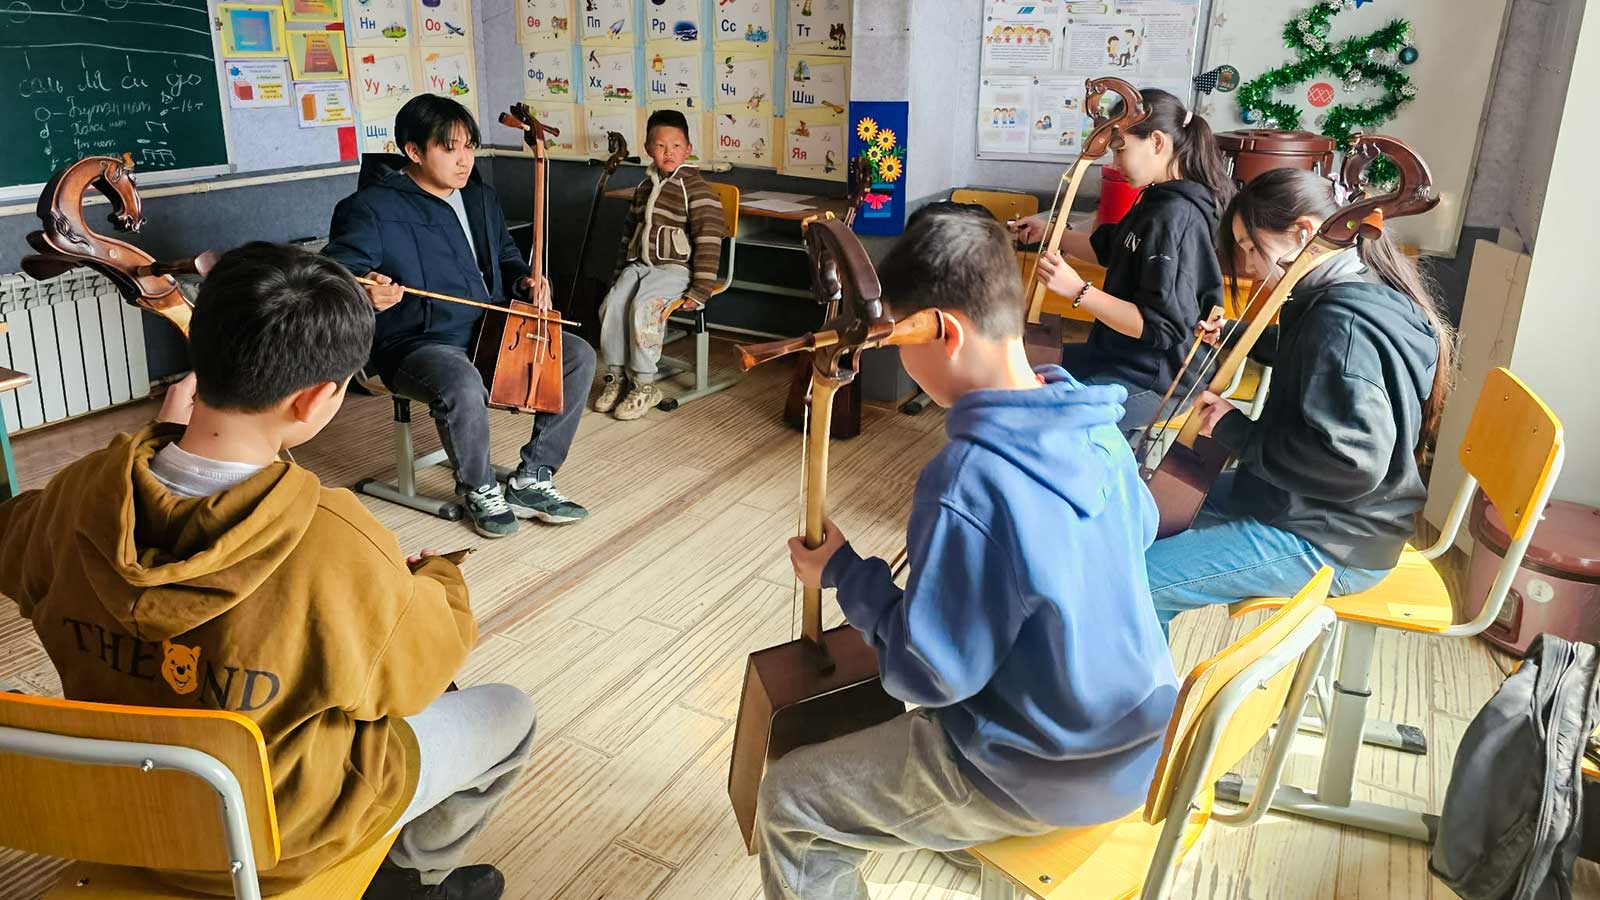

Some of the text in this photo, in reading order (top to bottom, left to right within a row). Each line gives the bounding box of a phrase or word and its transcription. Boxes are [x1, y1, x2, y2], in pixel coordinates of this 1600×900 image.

[360, 17, 376, 29] Нн
[425, 18, 441, 31] Оо
[527, 16, 541, 27] Өө
[587, 16, 600, 28] Пп
[652, 19, 666, 34] Рр
[721, 19, 737, 32] Сс
[797, 24, 811, 37] Тт
[528, 69, 545, 82] Фф
[589, 76, 602, 88] Хх
[364, 79, 380, 95] Уу
[430, 75, 445, 91] Үү
[651, 79, 666, 94] Цц
[721, 83, 736, 96] Чч
[792, 90, 815, 105] Шш
[720, 135, 741, 148] Юю
[792, 147, 807, 161] Яя
[63, 617, 160, 681] THE
